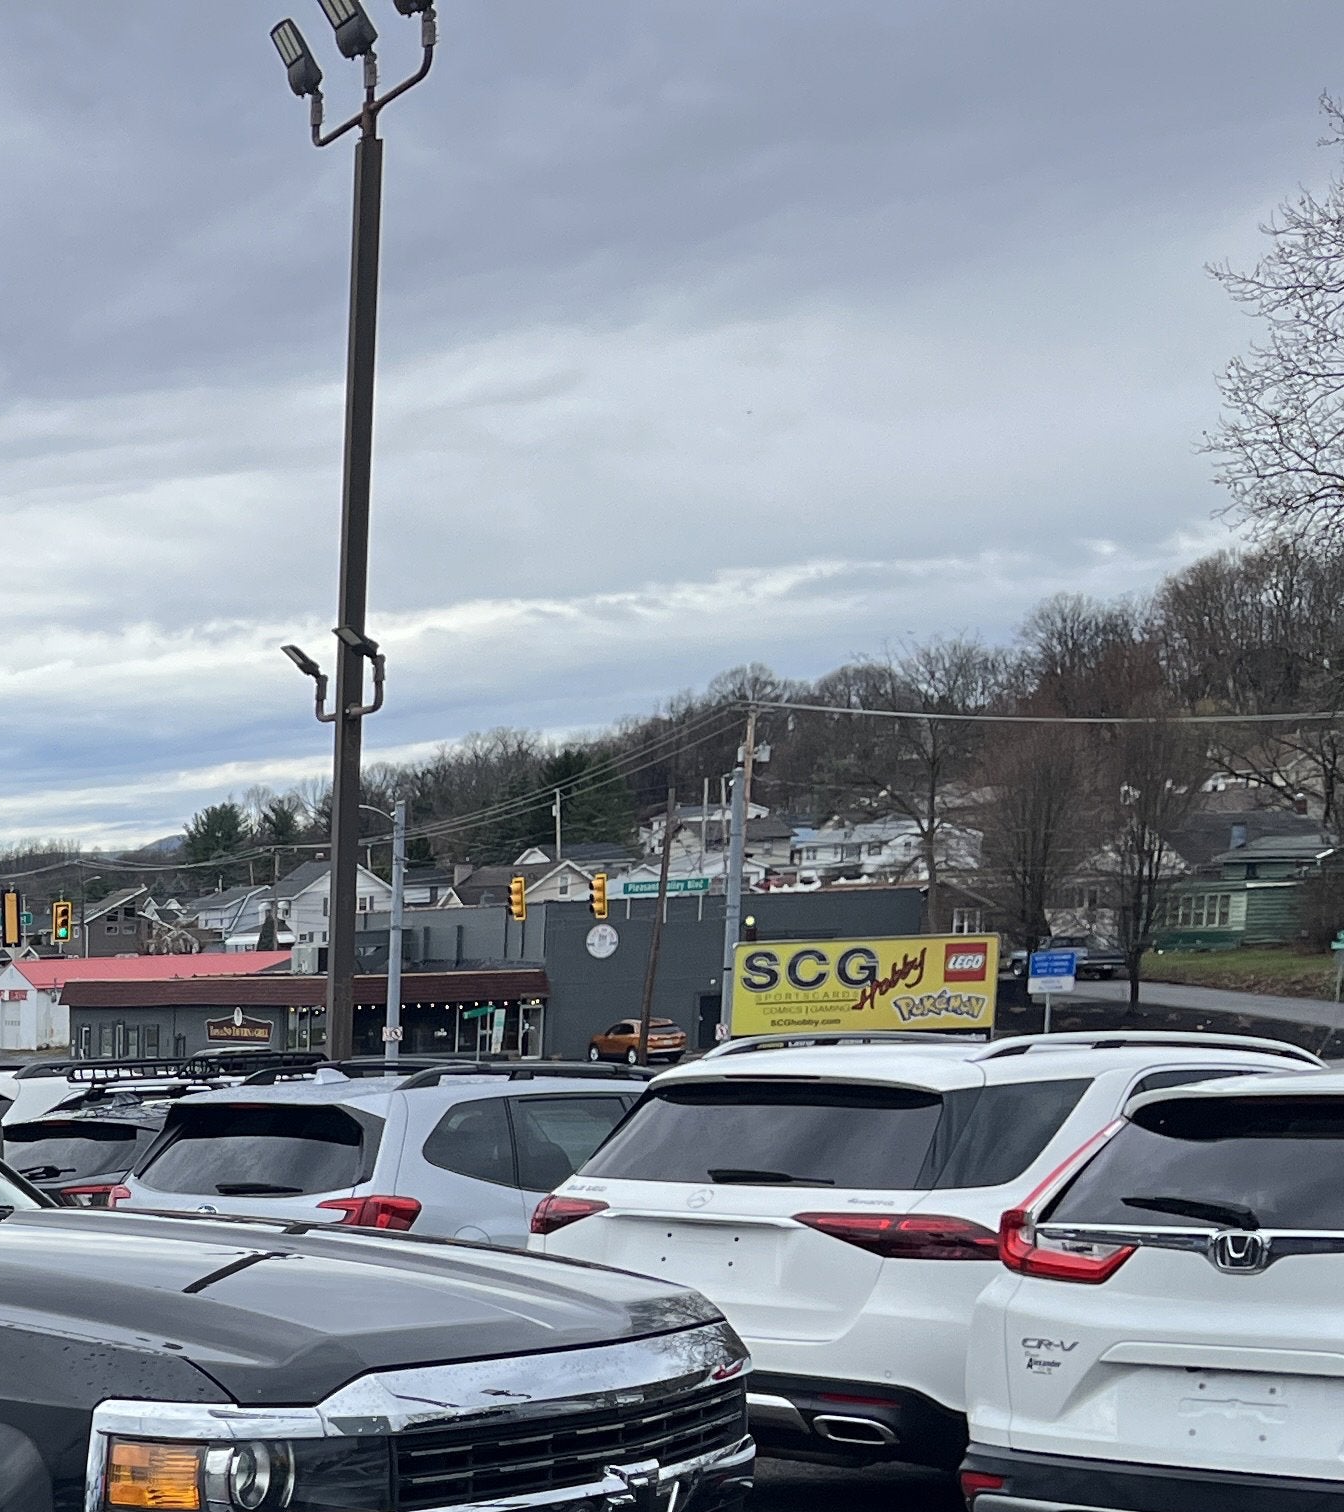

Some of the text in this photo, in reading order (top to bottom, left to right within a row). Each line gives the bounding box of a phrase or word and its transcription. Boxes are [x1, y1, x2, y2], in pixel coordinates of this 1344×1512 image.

[946, 952, 986, 971] LEGO
[741, 946, 928, 1010] SCG Hobby
[1021, 1337, 1080, 1352] CR-V
